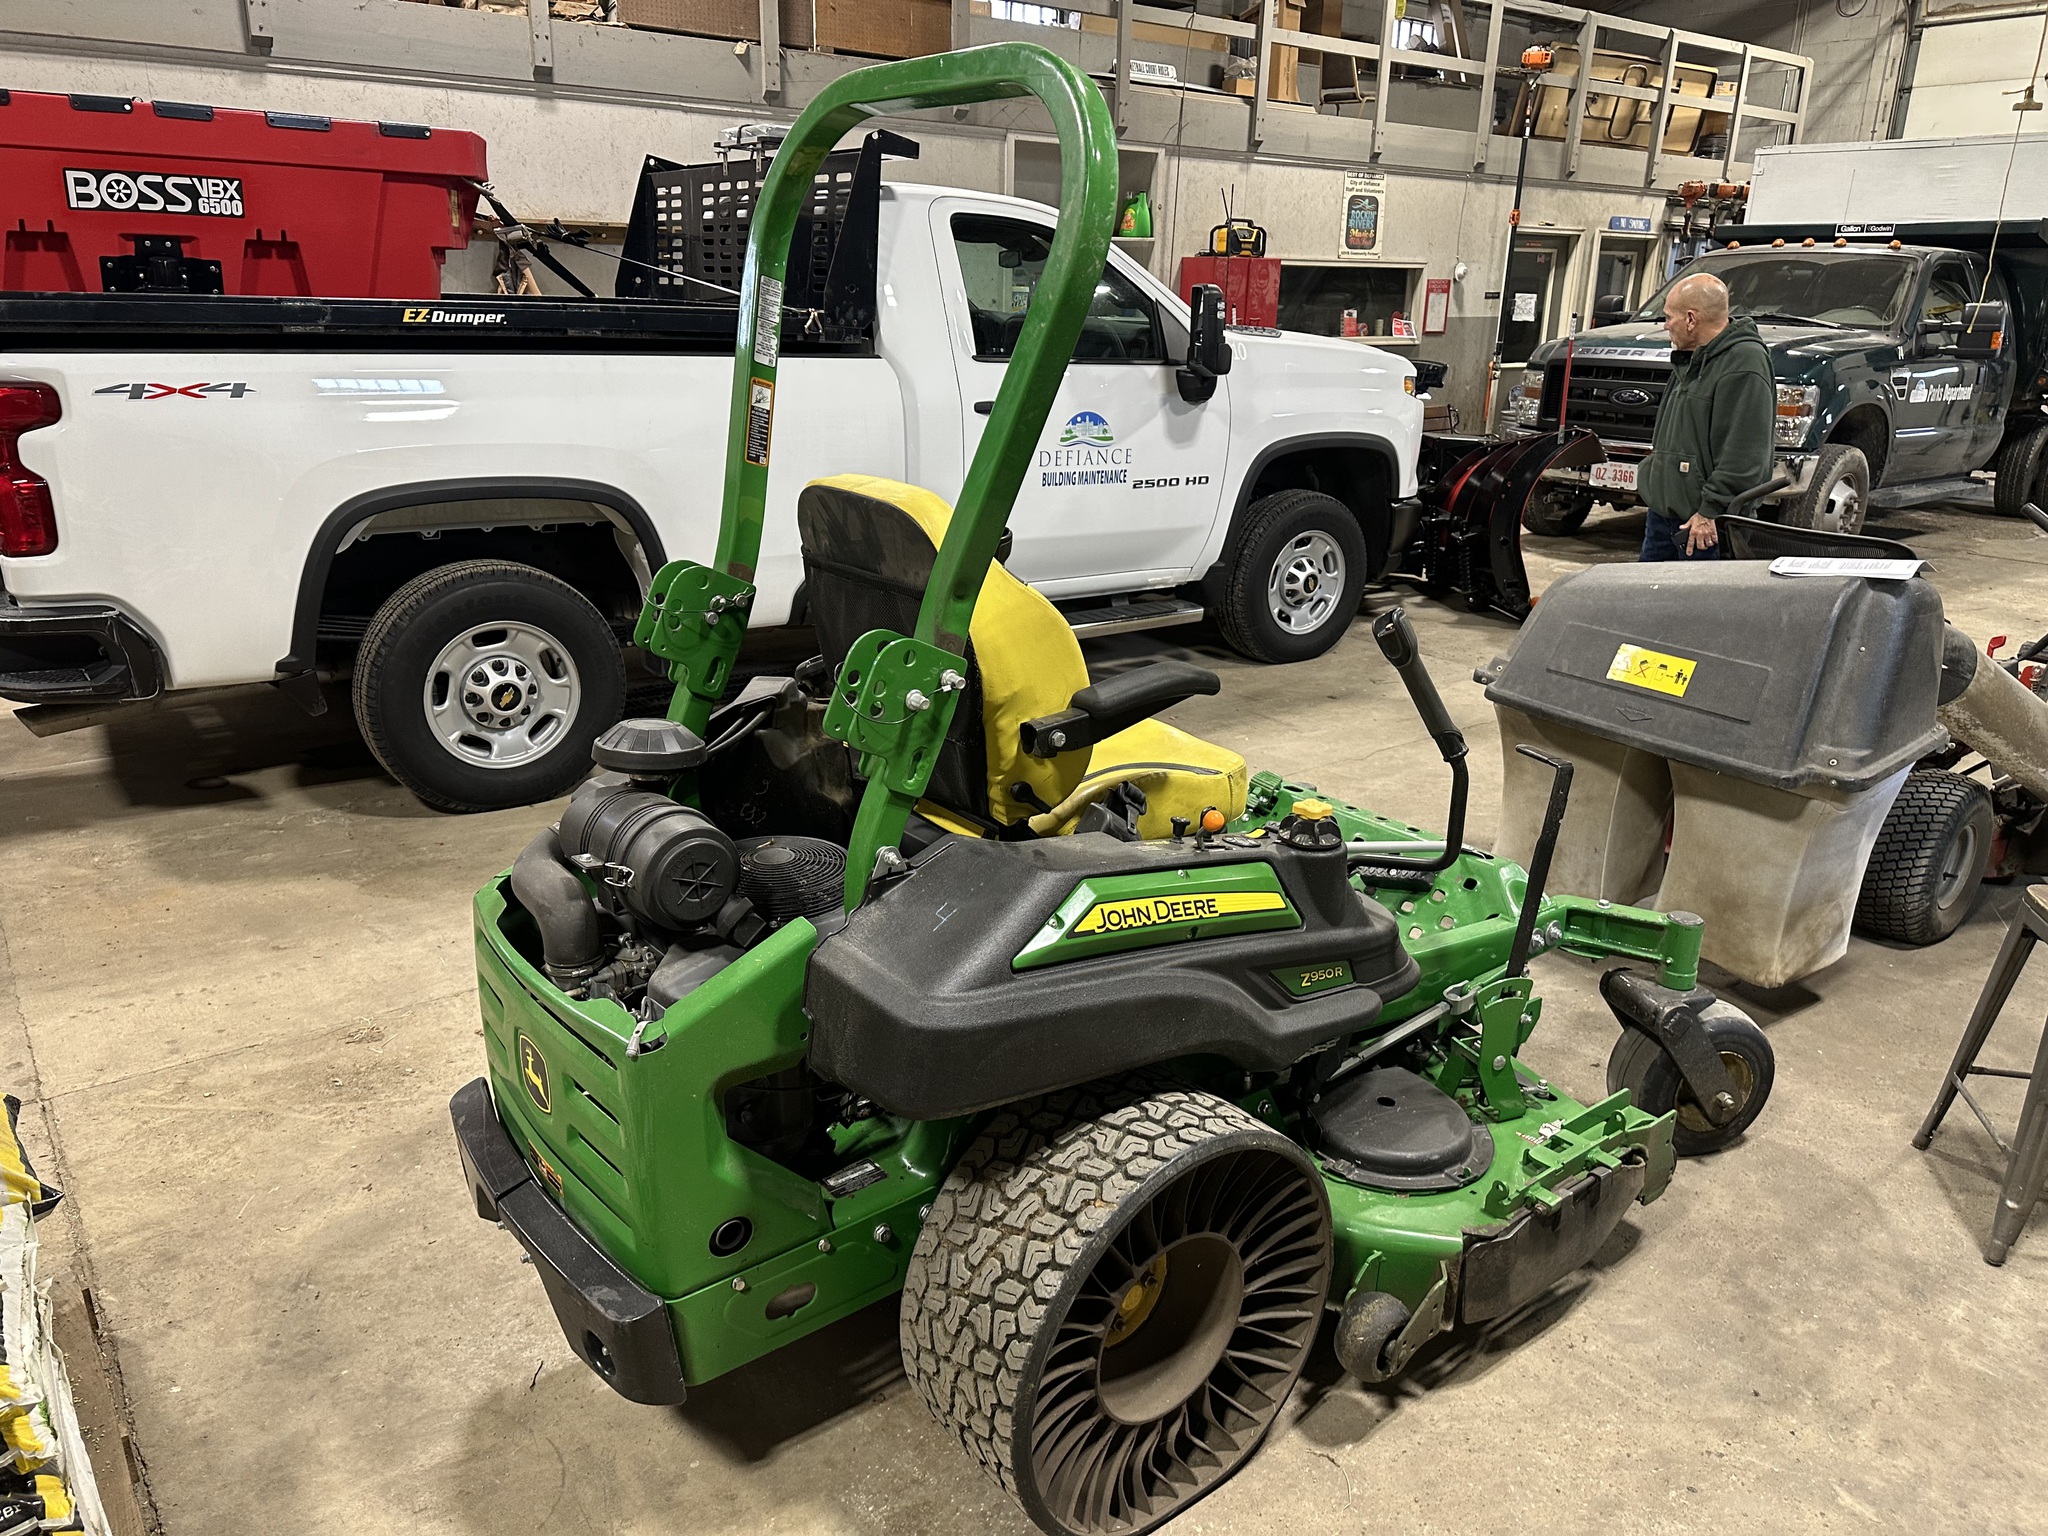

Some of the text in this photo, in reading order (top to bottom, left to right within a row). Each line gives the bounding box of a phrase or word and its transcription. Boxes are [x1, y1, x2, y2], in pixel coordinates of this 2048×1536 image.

[65, 170, 241, 213] BOSS VBX
[198, 197, 243, 216] 6500
[1351, 219, 1374, 229] RIVERS
[1620, 217, 1627, 228] NO
[1231, 342, 1247, 360] 10
[1578, 348, 1645, 357] SUPER
[1927, 384, 1943, 402] Parks
[1943, 383, 1973, 404] Department
[1039, 449, 1132, 467] DEFIANCE
[1042, 469, 1128, 487] BUILDING MAINTENANCE
[1132, 475, 1210, 489] 2500 HD
[1612, 469, 1634, 484] 3366
[1098, 898, 1219, 932] JOHN DEERE
[1301, 966, 1343, 987] Z950R
